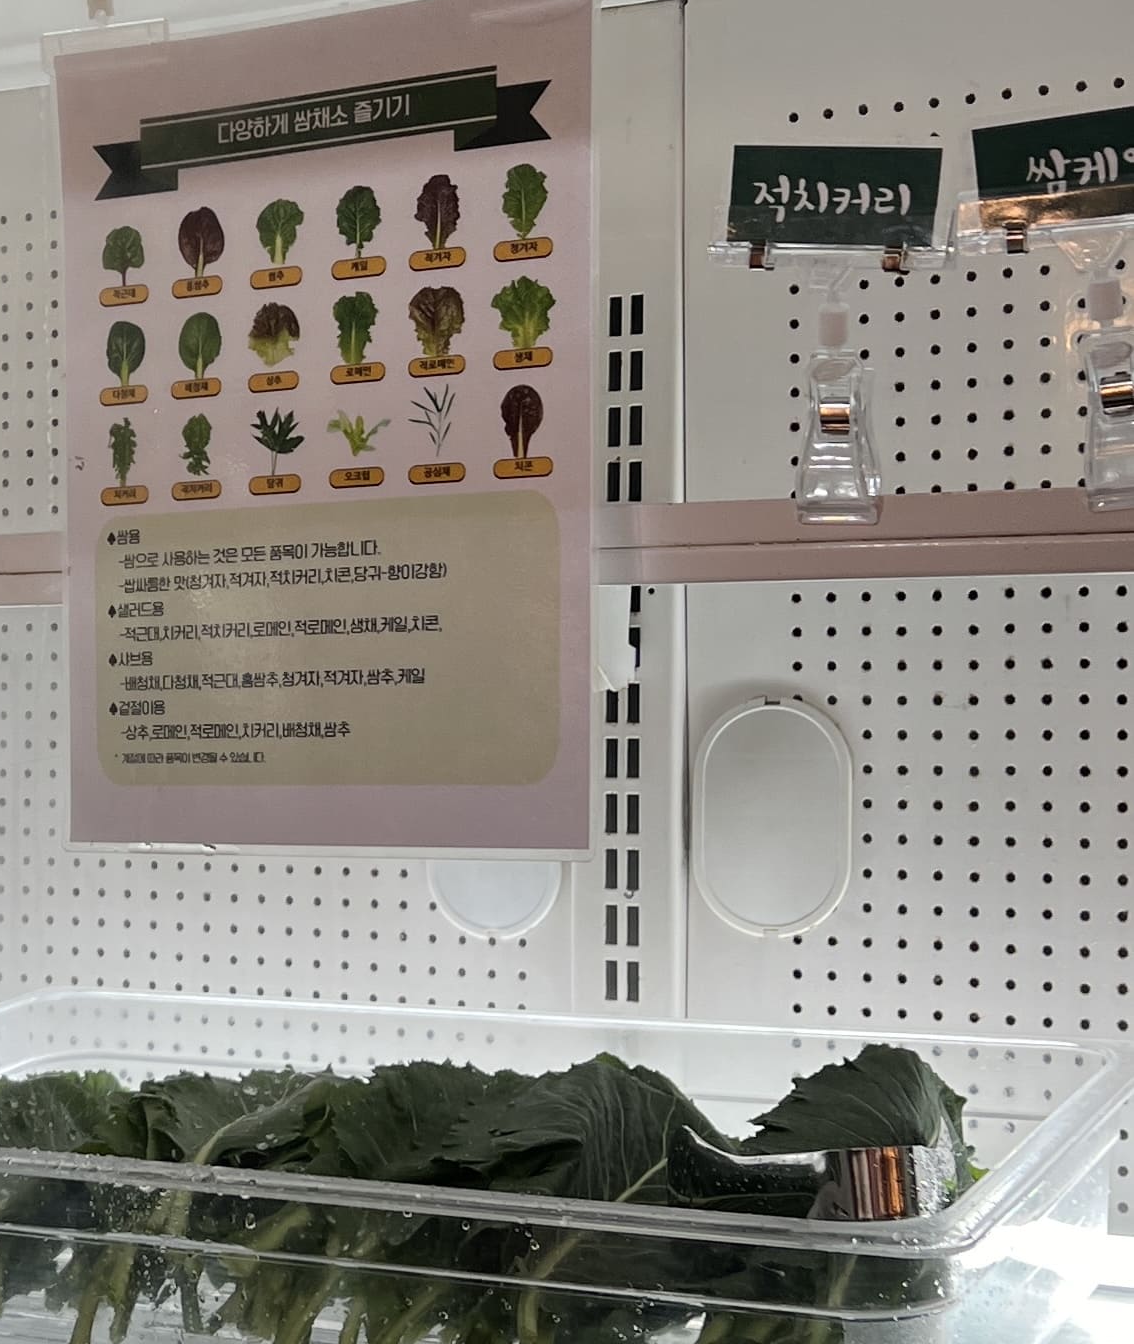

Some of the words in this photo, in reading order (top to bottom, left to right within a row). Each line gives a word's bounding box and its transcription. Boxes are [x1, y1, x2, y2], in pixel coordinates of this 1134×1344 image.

[217, 113, 290, 146] 다양하게
[293, 106, 350, 134] 쌈채소
[353, 93, 411, 122] 즐기기
[1025, 146, 1134, 195] 쌈케
[753, 173, 912, 223] 적치커리
[161, 549, 211, 567] 사용하는
[213, 547, 240, 564] 것은
[241, 545, 267, 561] 모든
[269, 542, 308, 561] 품목이
